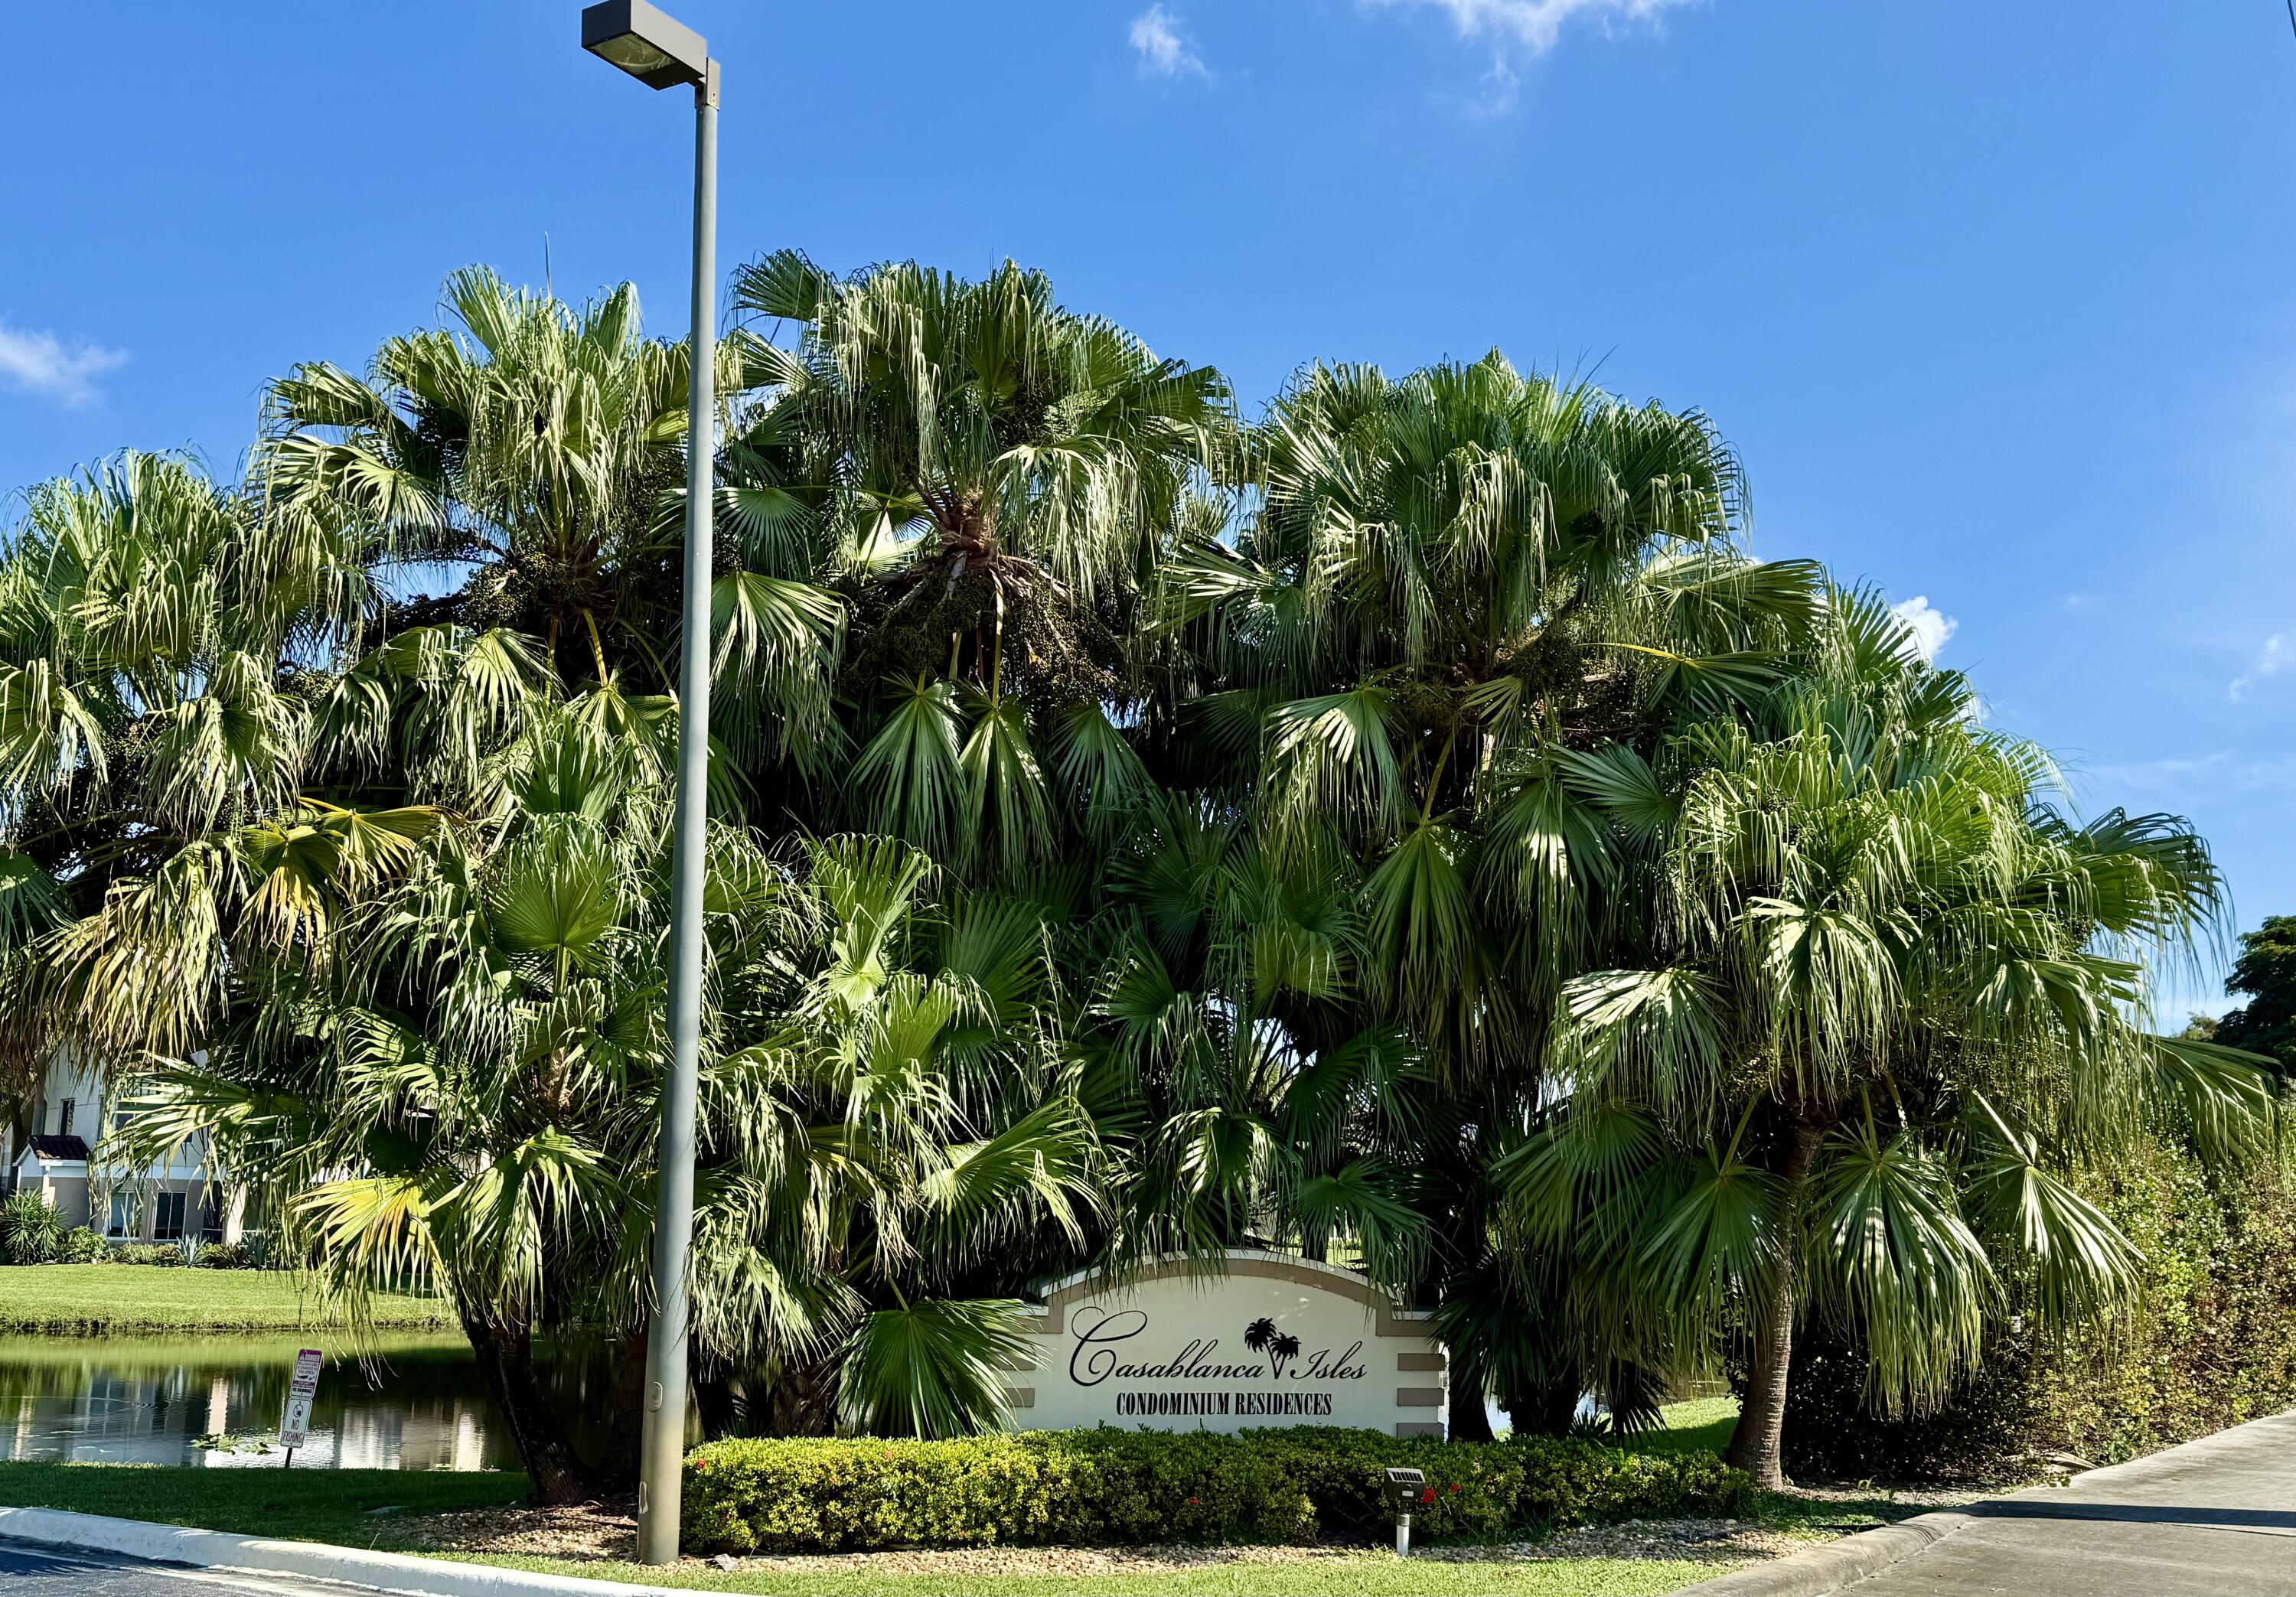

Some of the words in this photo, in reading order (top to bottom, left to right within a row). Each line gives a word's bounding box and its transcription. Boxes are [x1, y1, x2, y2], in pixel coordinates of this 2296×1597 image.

[1070, 1306, 1265, 1387] Casablanca
[1290, 1341, 1368, 1380] Isles
[1117, 1393, 1230, 1416] CONDOMINIUM
[1234, 1393, 1332, 1416] RESIDENCES
[291, 1419, 299, 1429] NO
[283, 1431, 303, 1442] FISHING
